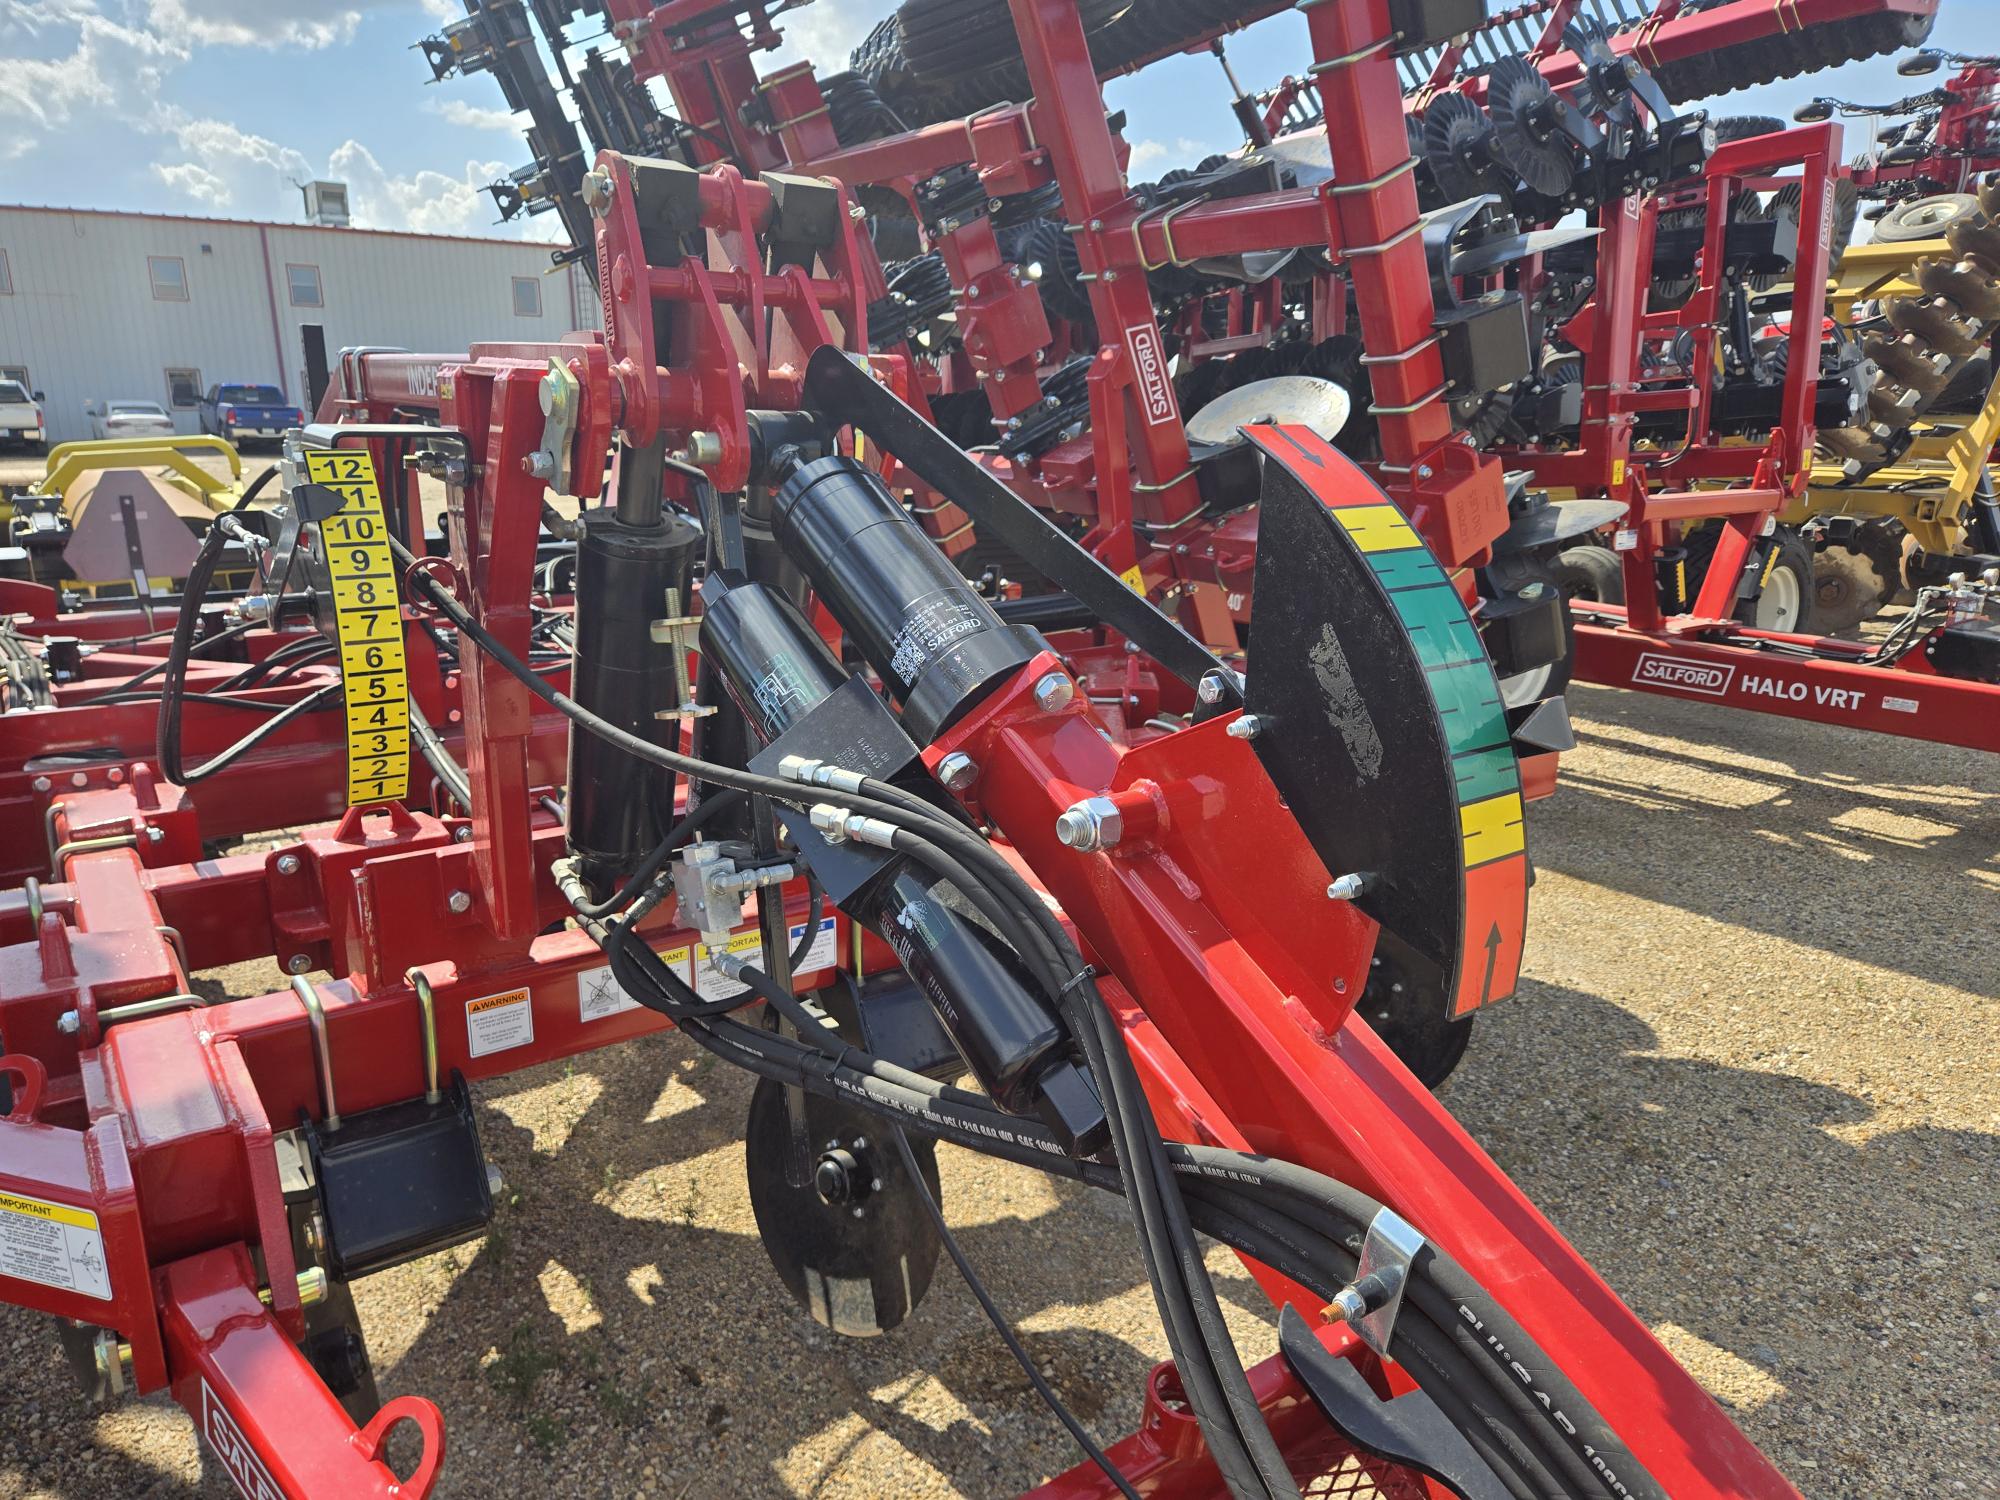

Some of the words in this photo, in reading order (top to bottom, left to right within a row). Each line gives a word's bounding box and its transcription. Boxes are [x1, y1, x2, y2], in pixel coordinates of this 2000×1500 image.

[1136, 333, 1168, 416] SALFORD
[928, 619, 981, 651] SALFORD
[1642, 661, 1723, 687] SALFORD
[1740, 675, 1808, 702] HALO
[1814, 686, 1866, 711] VRT
[480, 992, 525, 1010] WARNING
